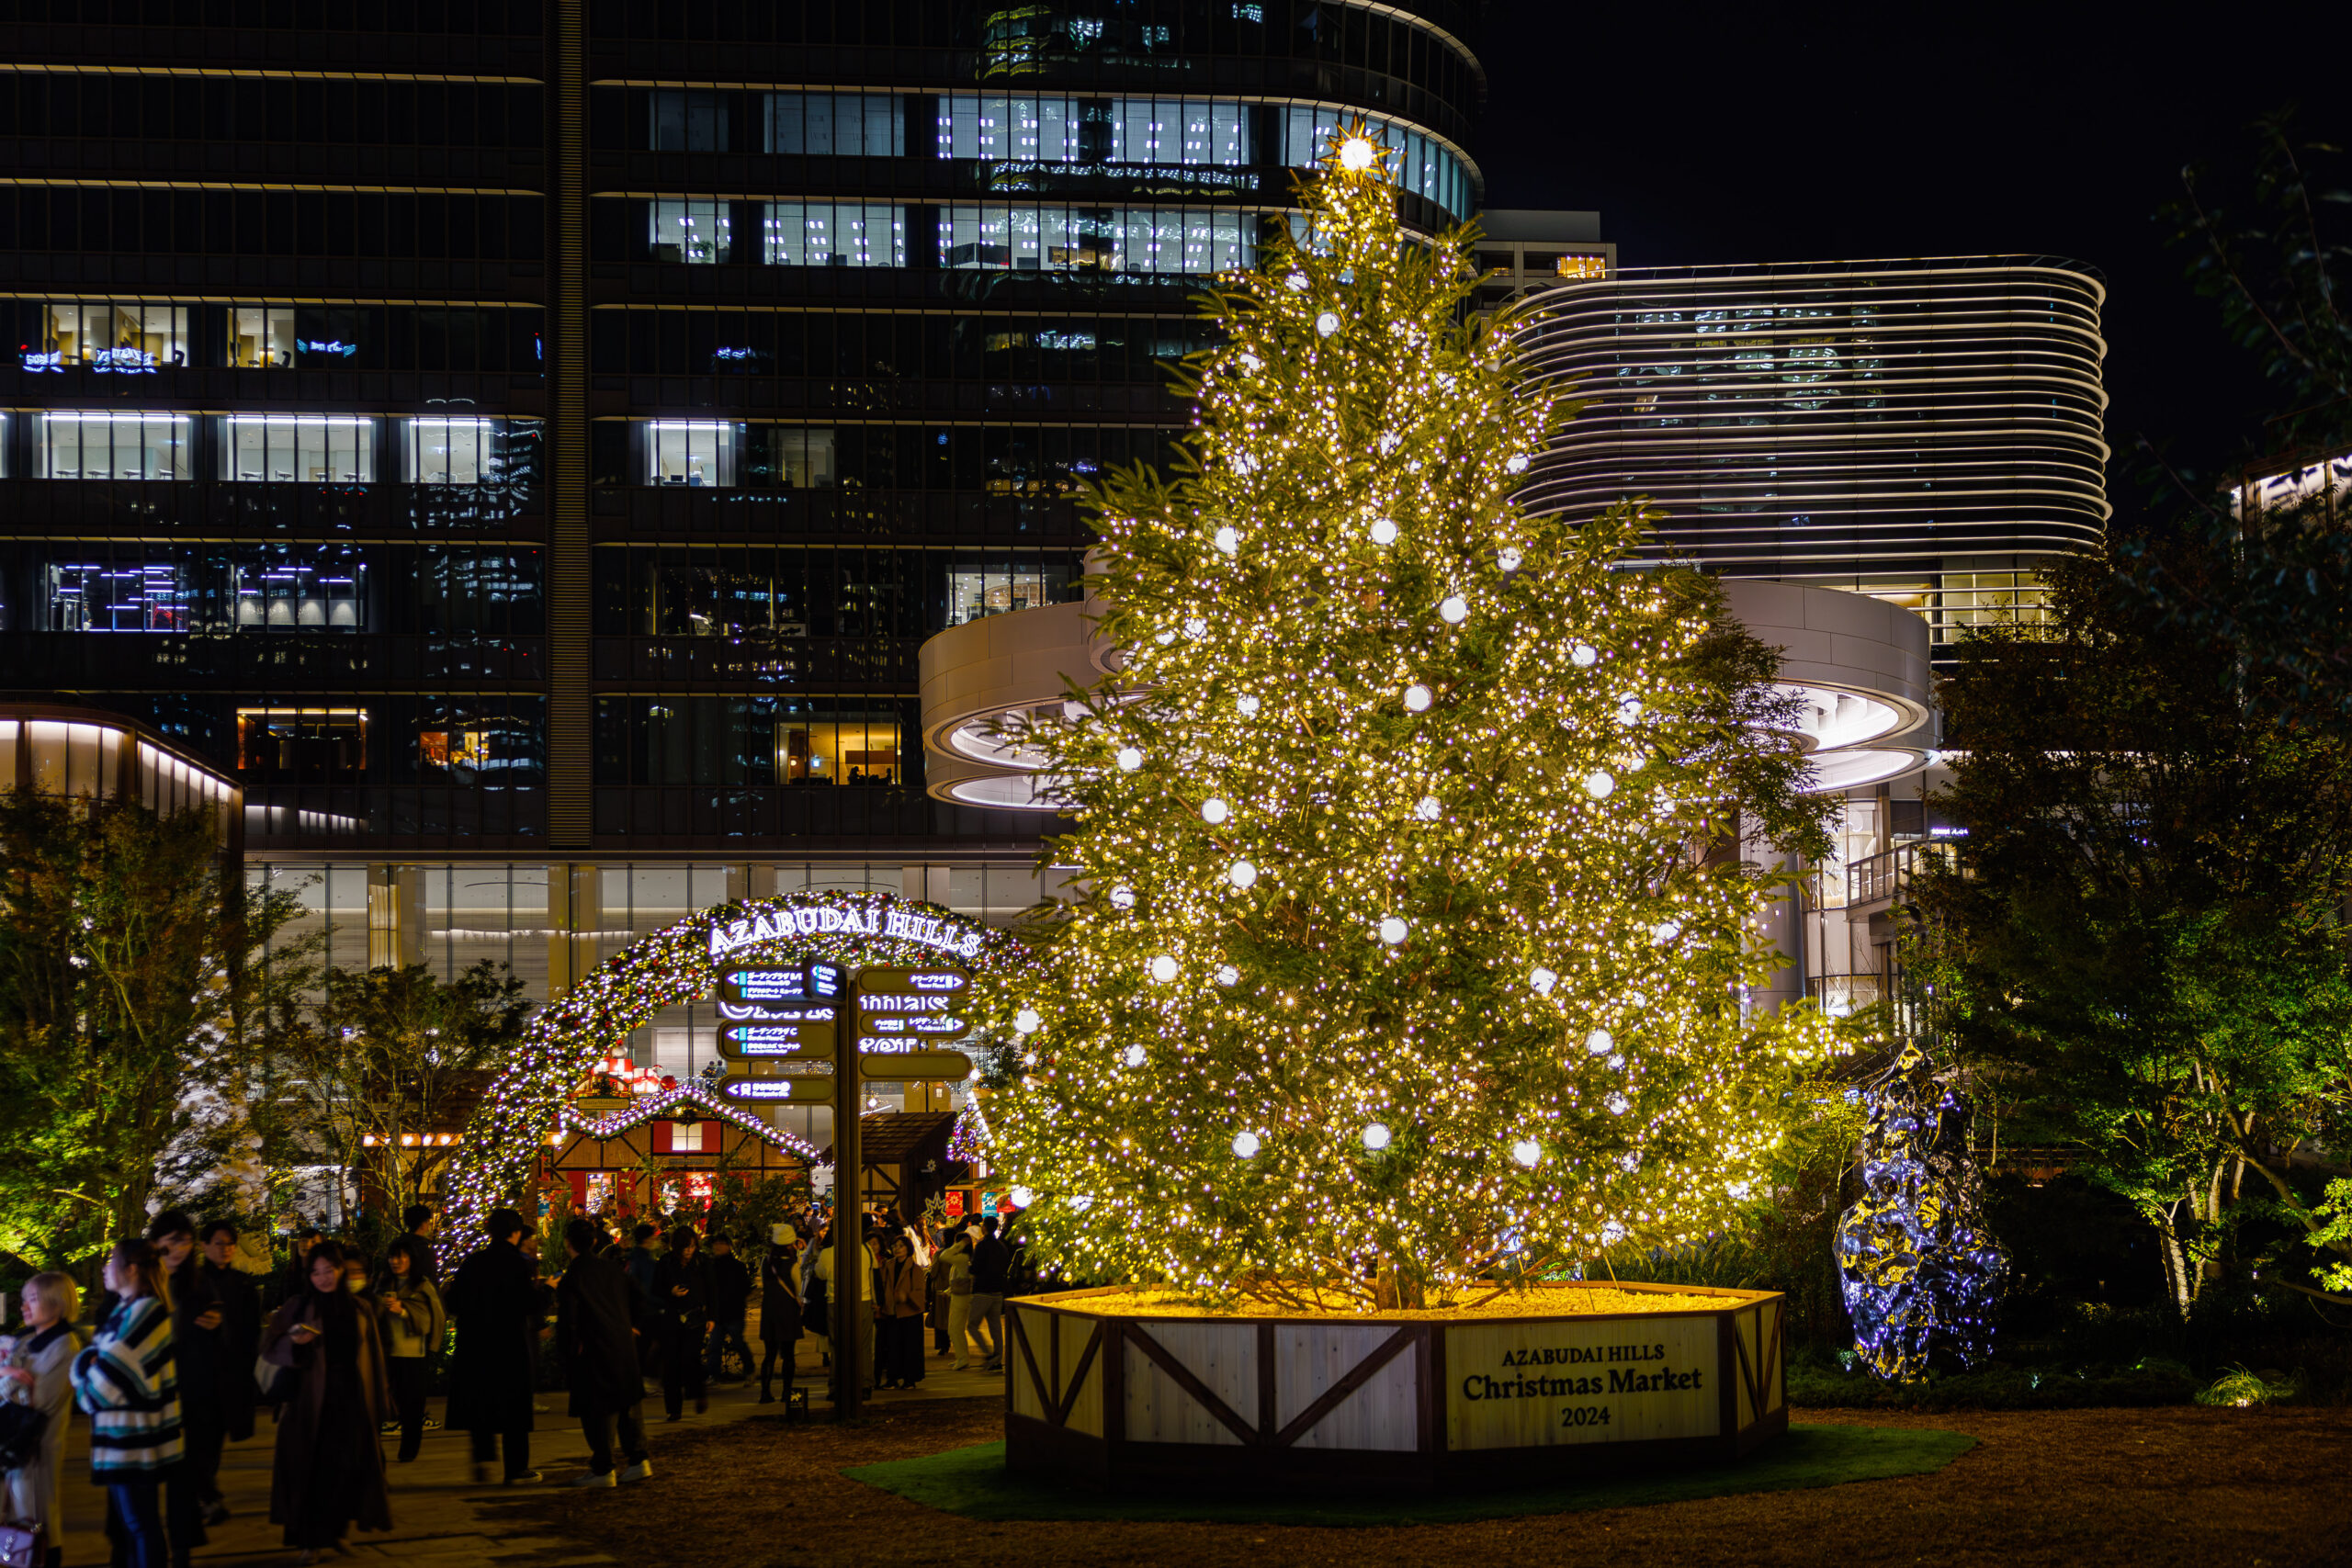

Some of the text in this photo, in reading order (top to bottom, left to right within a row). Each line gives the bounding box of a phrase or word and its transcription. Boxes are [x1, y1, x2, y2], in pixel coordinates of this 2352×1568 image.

[709, 908, 982, 958] AZABUDAI HILLS
[1502, 1344, 1665, 1367] AZABUDAI HILLS
[1464, 1367, 1702, 1401] Christmas Market
[1562, 1406, 1611, 1427] 2024
